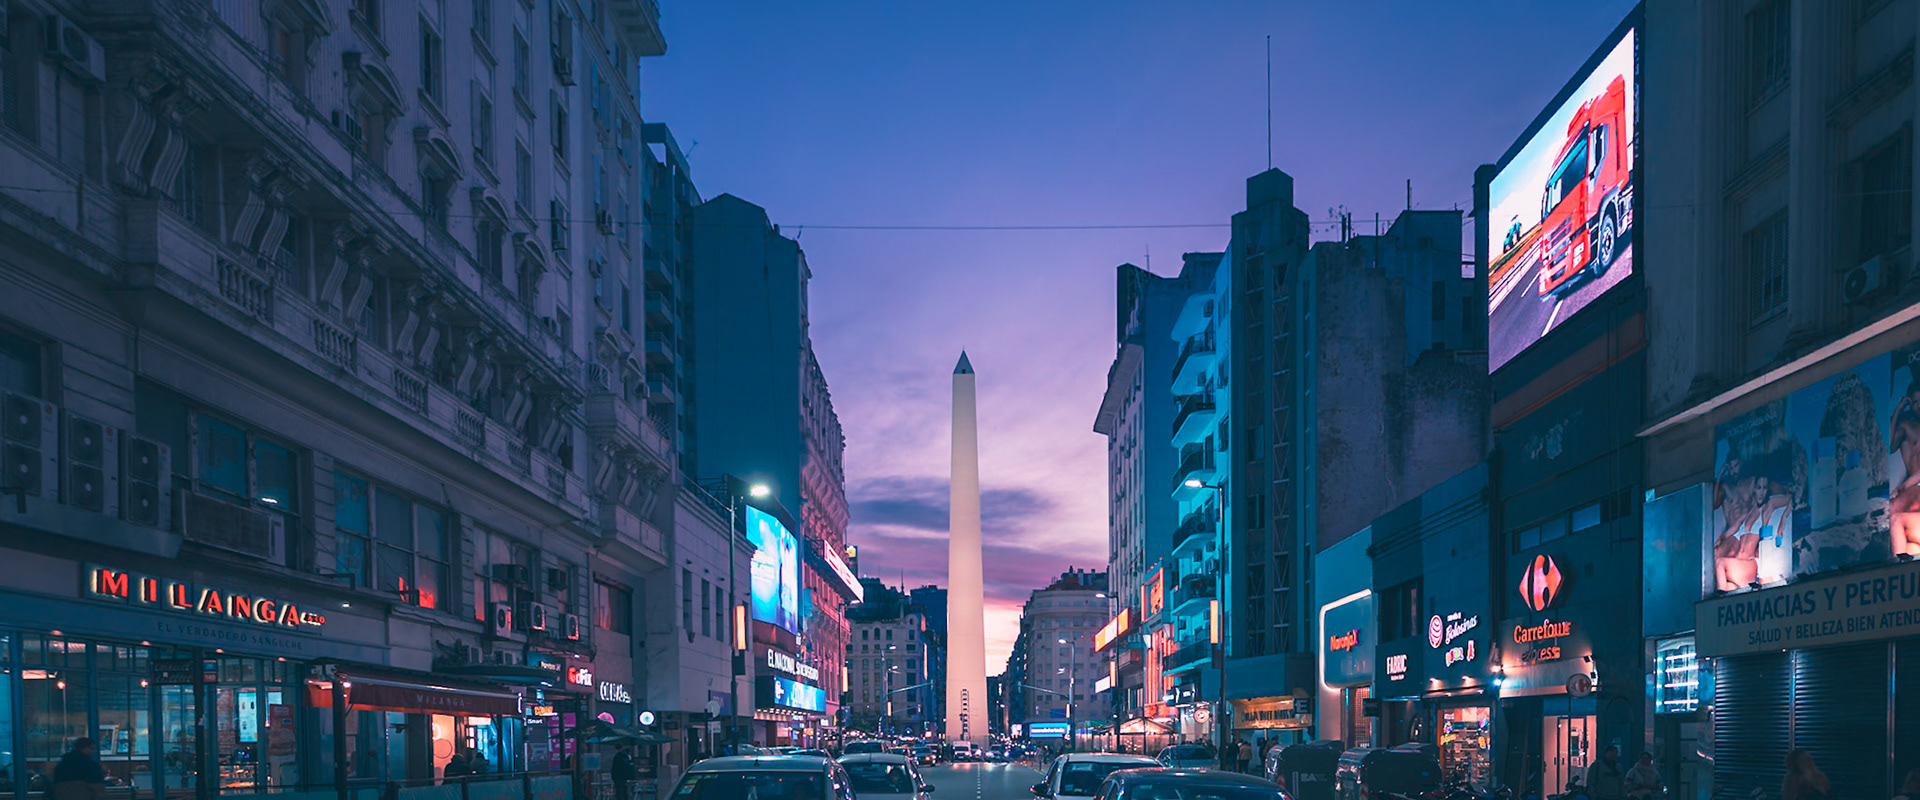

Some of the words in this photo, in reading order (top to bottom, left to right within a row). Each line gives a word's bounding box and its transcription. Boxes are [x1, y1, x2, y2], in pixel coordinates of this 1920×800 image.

[91, 567, 300, 627] MILANGA
[1717, 590, 1816, 628] FARMACIAS
[1823, 586, 1838, 612] Y
[1845, 571, 1920, 608] PERFU
[157, 621, 173, 633] EL
[178, 625, 247, 643] VERDADERO
[1514, 618, 1572, 644] Carrefour
[1748, 628, 1782, 645] SALUD
[1784, 627, 1793, 641] Y
[1796, 620, 1844, 639] BELLEZA
[1847, 615, 1876, 633] BIEN
[1386, 654, 1408, 675] FABRIC
[1522, 646, 1561, 665] express
[416, 694, 465, 706] MILANGA
